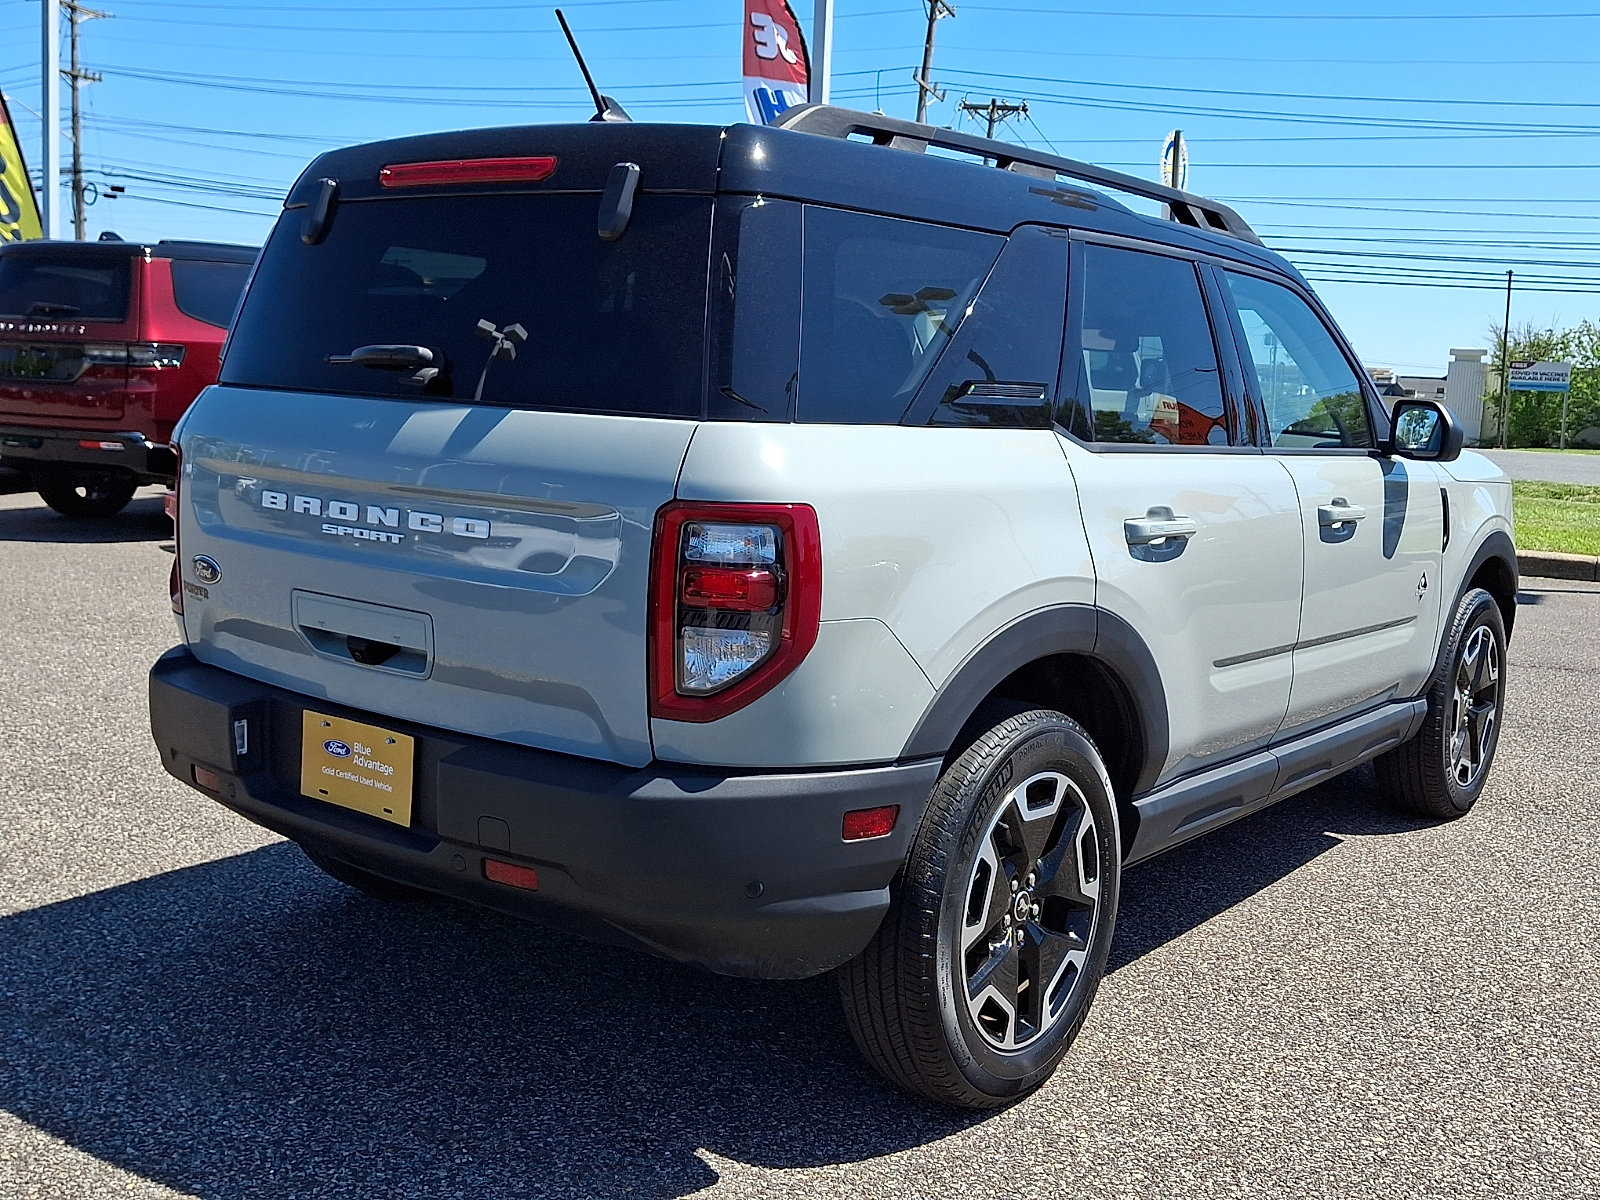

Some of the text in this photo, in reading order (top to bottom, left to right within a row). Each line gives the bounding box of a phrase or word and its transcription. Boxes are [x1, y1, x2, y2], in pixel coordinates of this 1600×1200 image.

[261, 490, 491, 539] BRONCO
[321, 523, 405, 544] SPORT
[353, 742, 372, 755] Blue
[353, 755, 394, 776] Advantage
[321, 765, 393, 793] Gold Certified Used Vehicle
[962, 757, 1014, 858] MICHELIN
